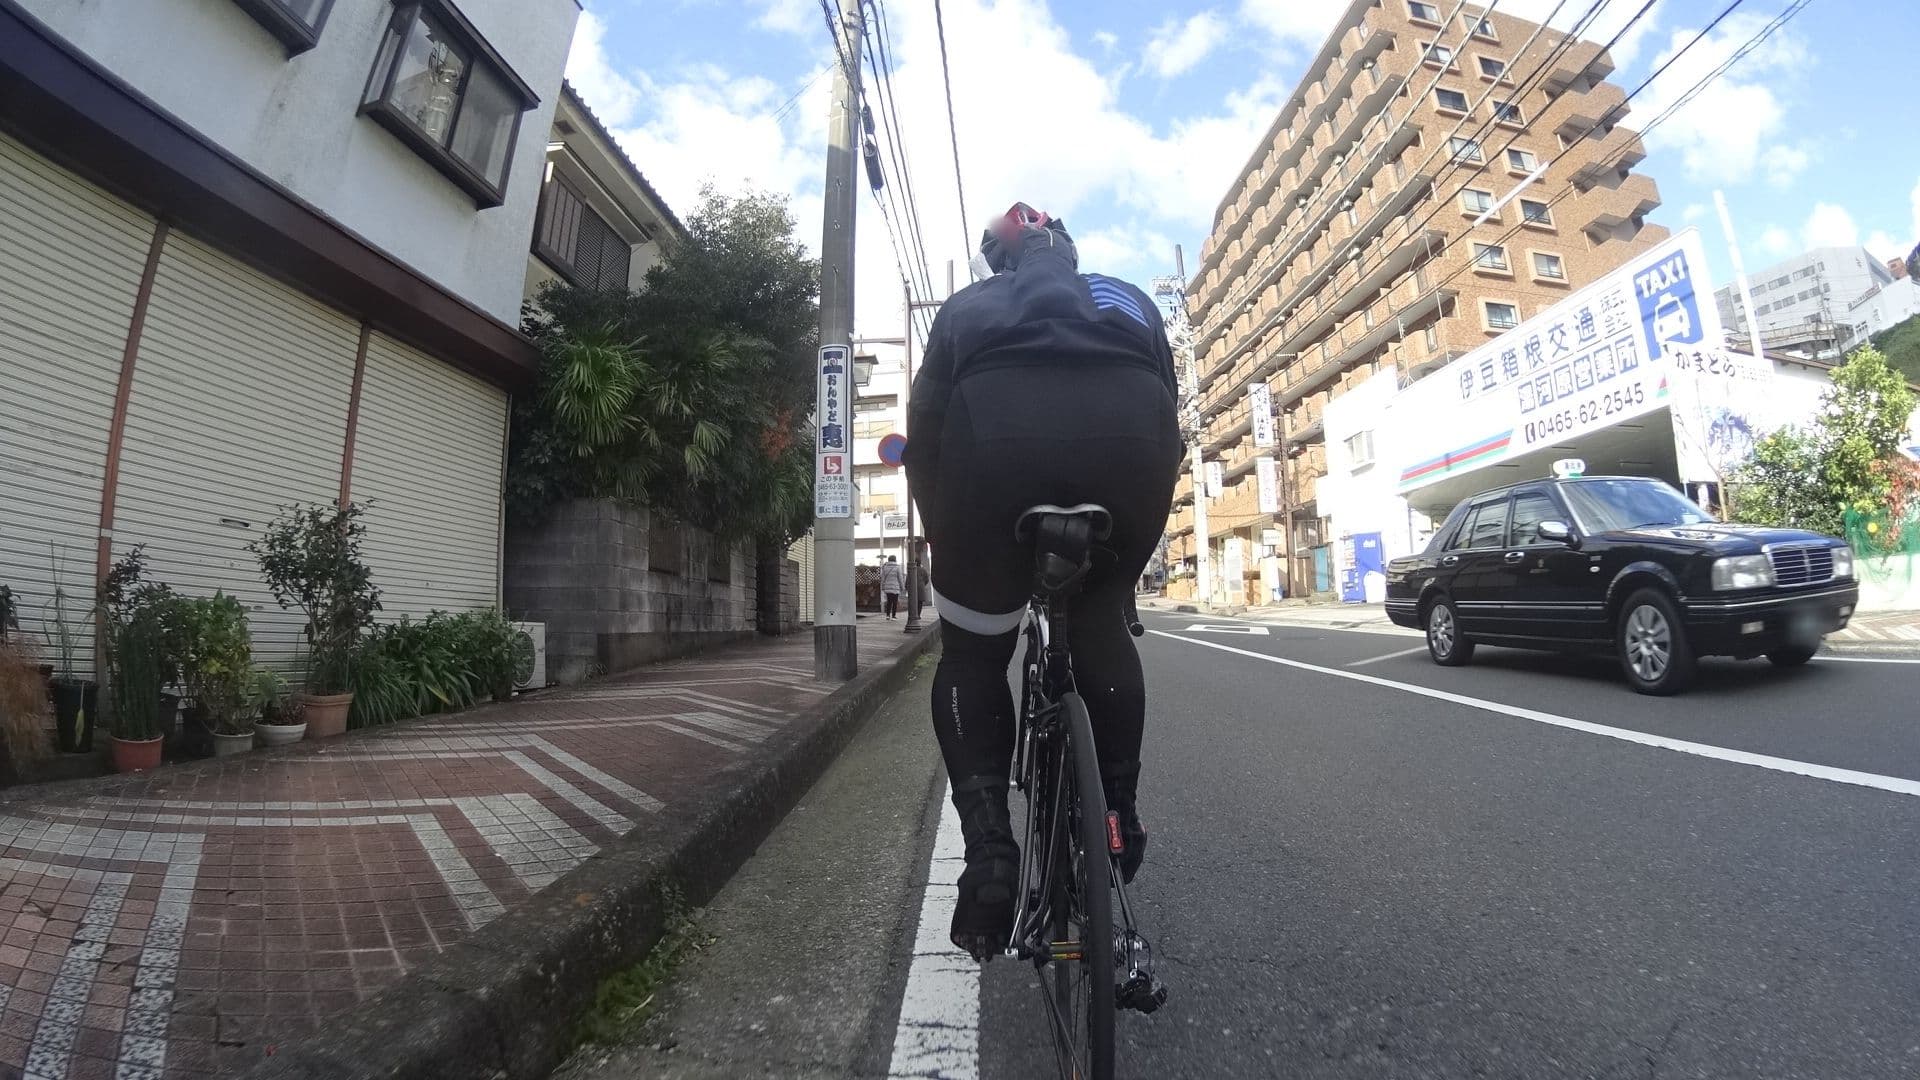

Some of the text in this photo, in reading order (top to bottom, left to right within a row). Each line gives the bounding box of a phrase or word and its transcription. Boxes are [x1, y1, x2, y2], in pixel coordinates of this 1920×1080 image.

[1635, 263, 1688, 298] TAXI
[1459, 305, 1597, 399] 伊豆箱根交通
